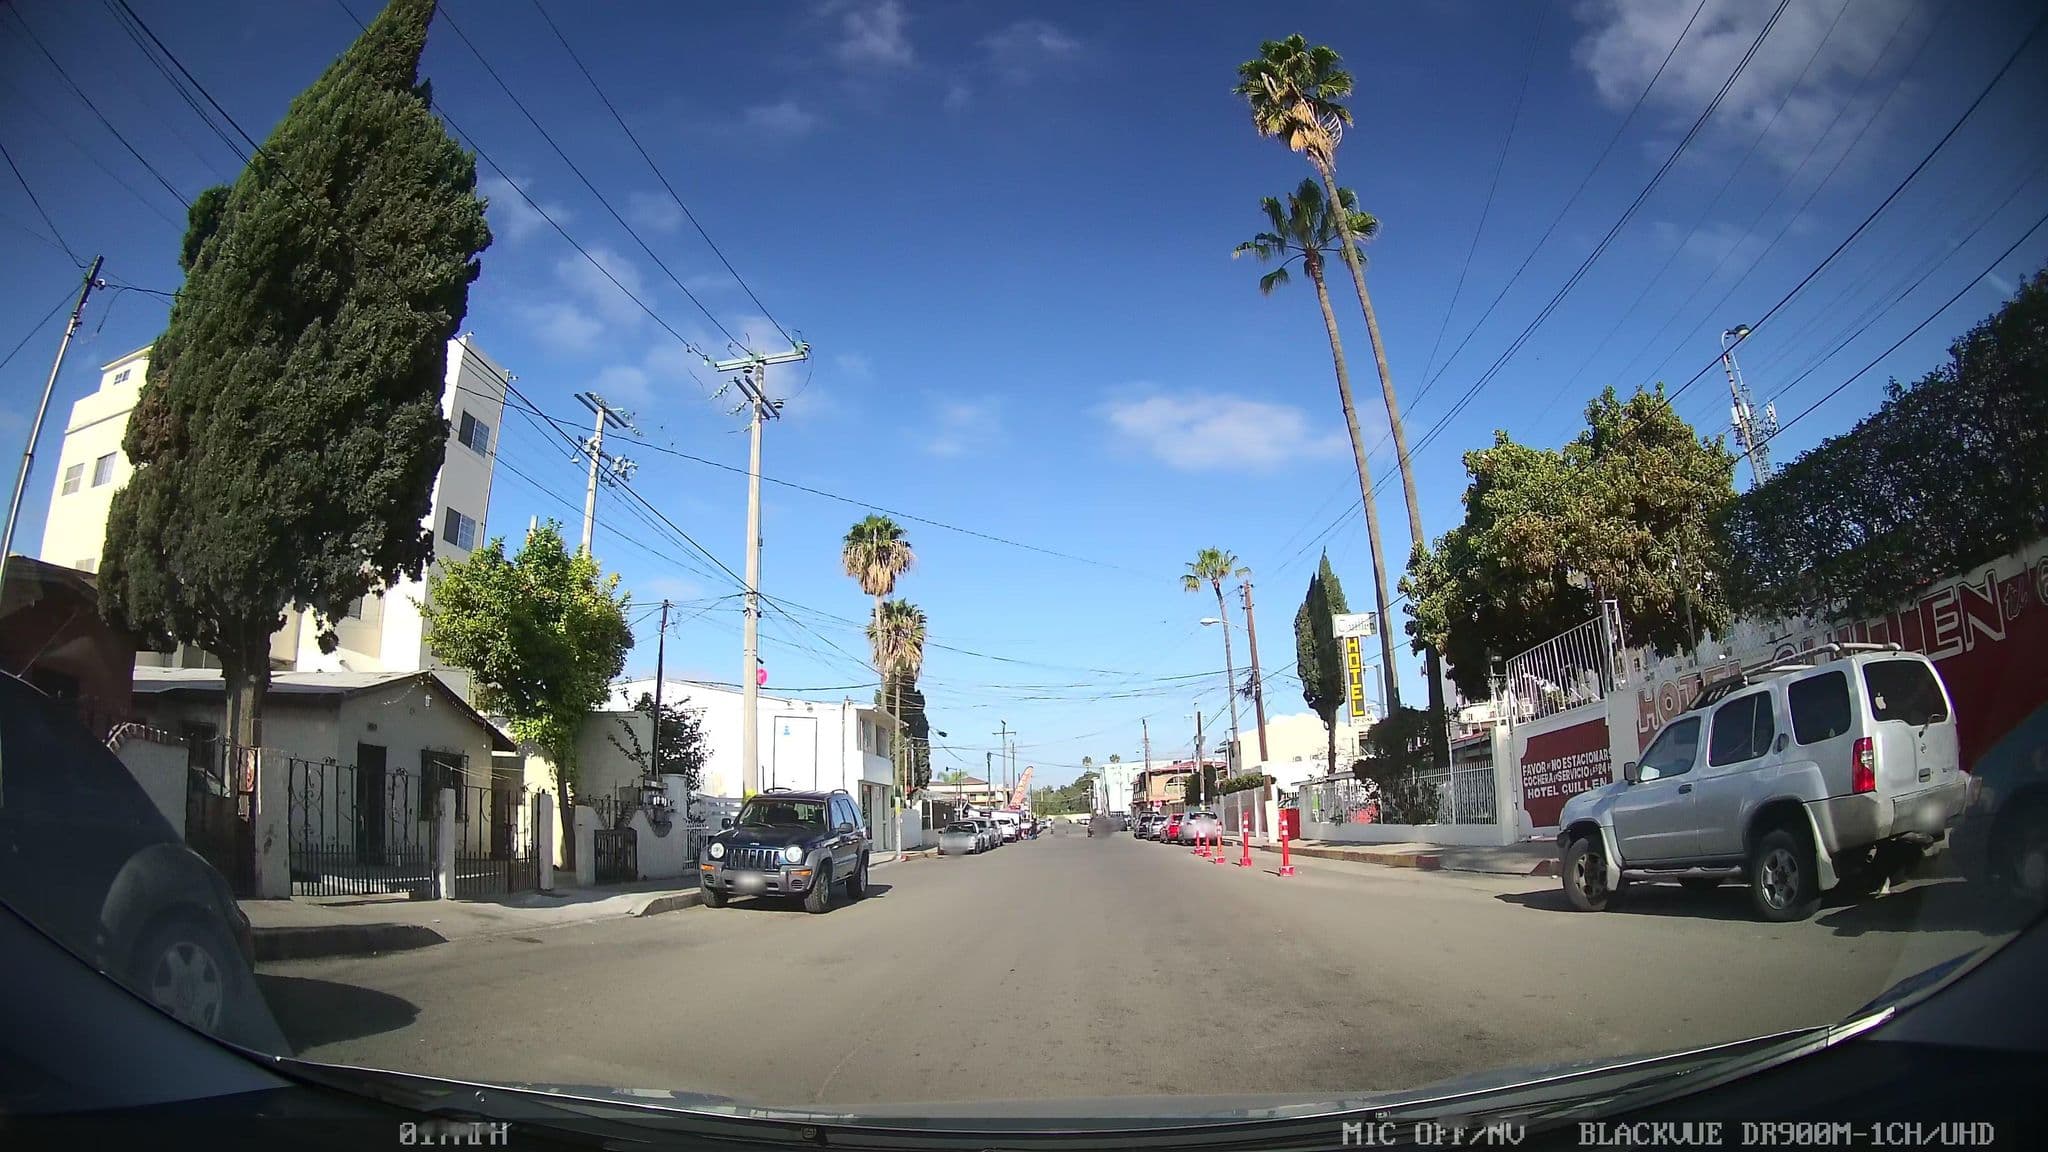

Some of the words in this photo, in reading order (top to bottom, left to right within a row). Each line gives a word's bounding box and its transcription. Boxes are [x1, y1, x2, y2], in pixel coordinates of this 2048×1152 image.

[1346, 637, 1366, 716] HOTEL
[1522, 761, 1546, 777] FAVOR
[1551, 758, 1562, 771] NO
[1562, 749, 1609, 769] ESTACIONAR
[1523, 772, 1554, 787] COCHERA
[1556, 765, 1590, 782] SERVICIO
[1598, 762, 1607, 775] 24
[1527, 785, 1559, 799] HOTEL
[1561, 777, 1608, 796] GUILLEN
